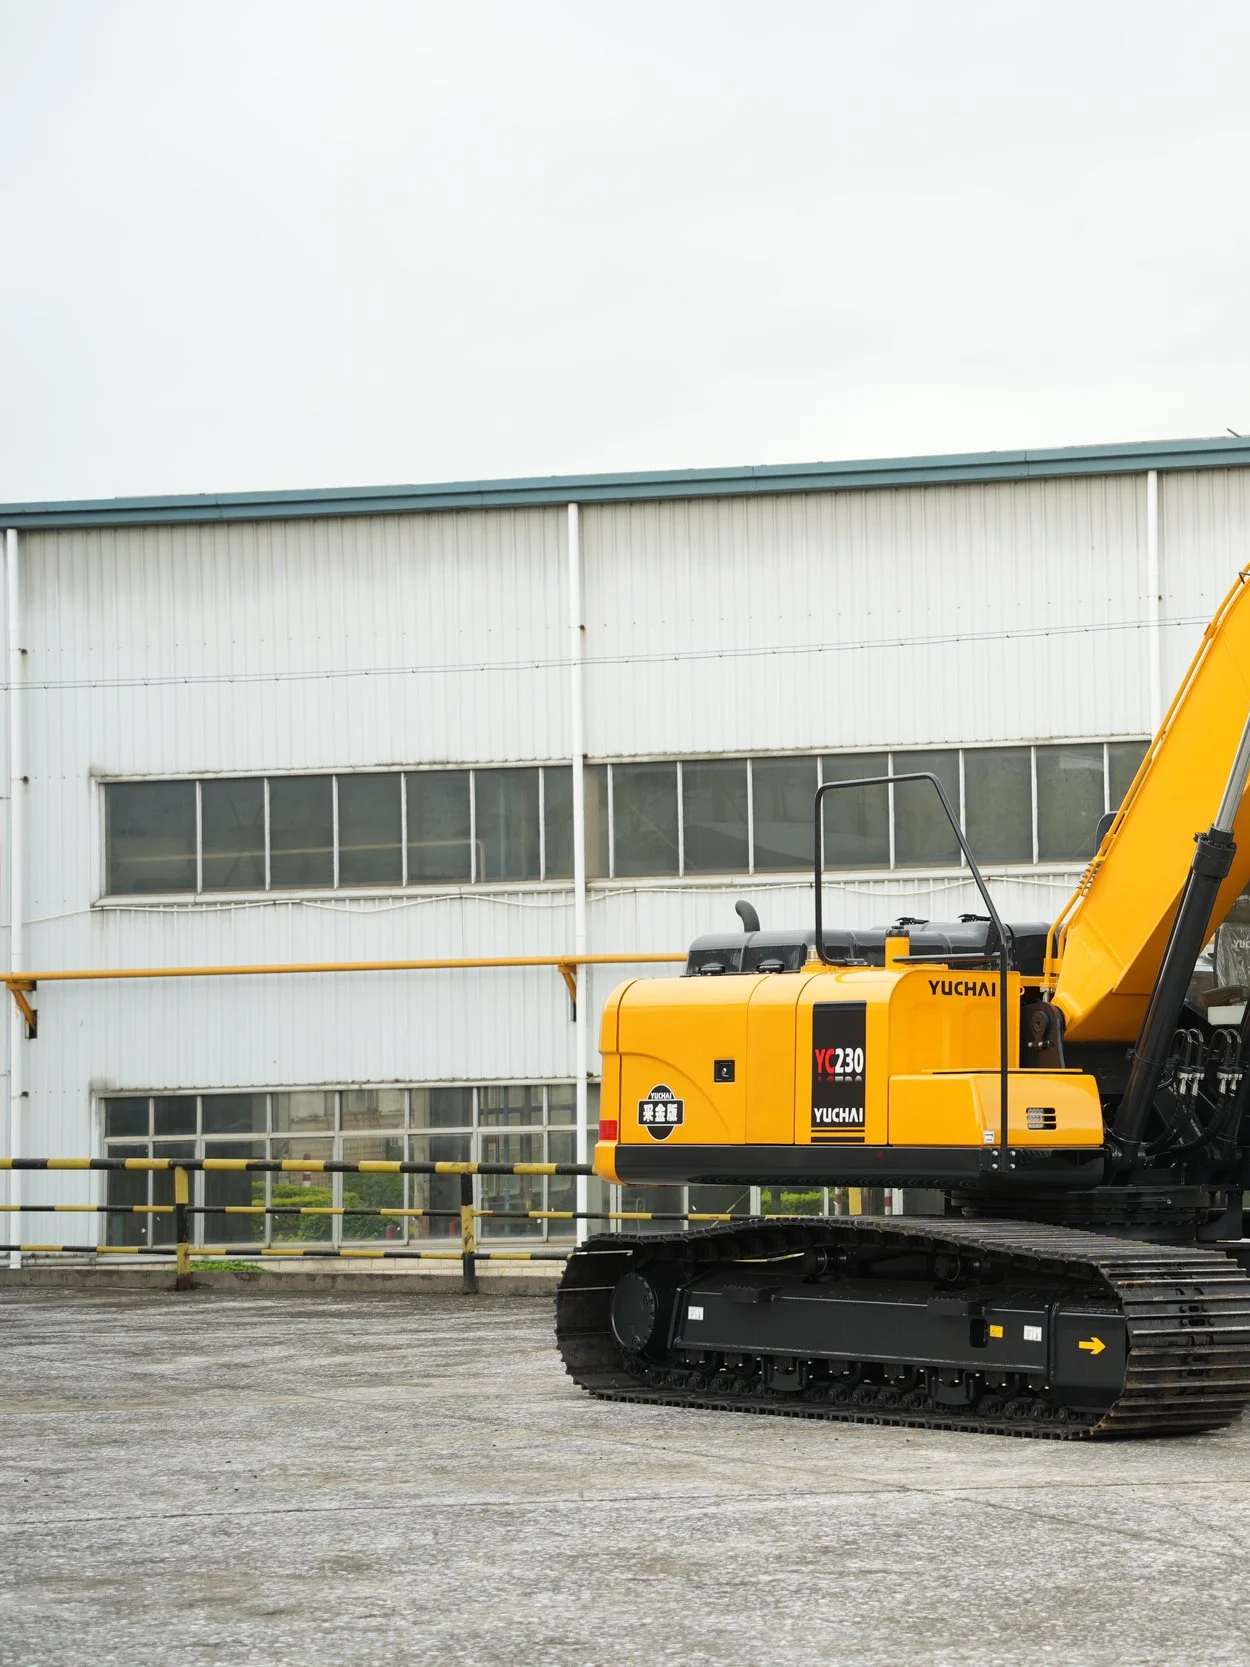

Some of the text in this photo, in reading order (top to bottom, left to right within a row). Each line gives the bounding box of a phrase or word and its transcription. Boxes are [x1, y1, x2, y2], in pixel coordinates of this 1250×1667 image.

[928, 980, 996, 997] YUCHAI
[815, 1047, 864, 1074] YC230
[814, 1107, 863, 1122] YUCHAI
